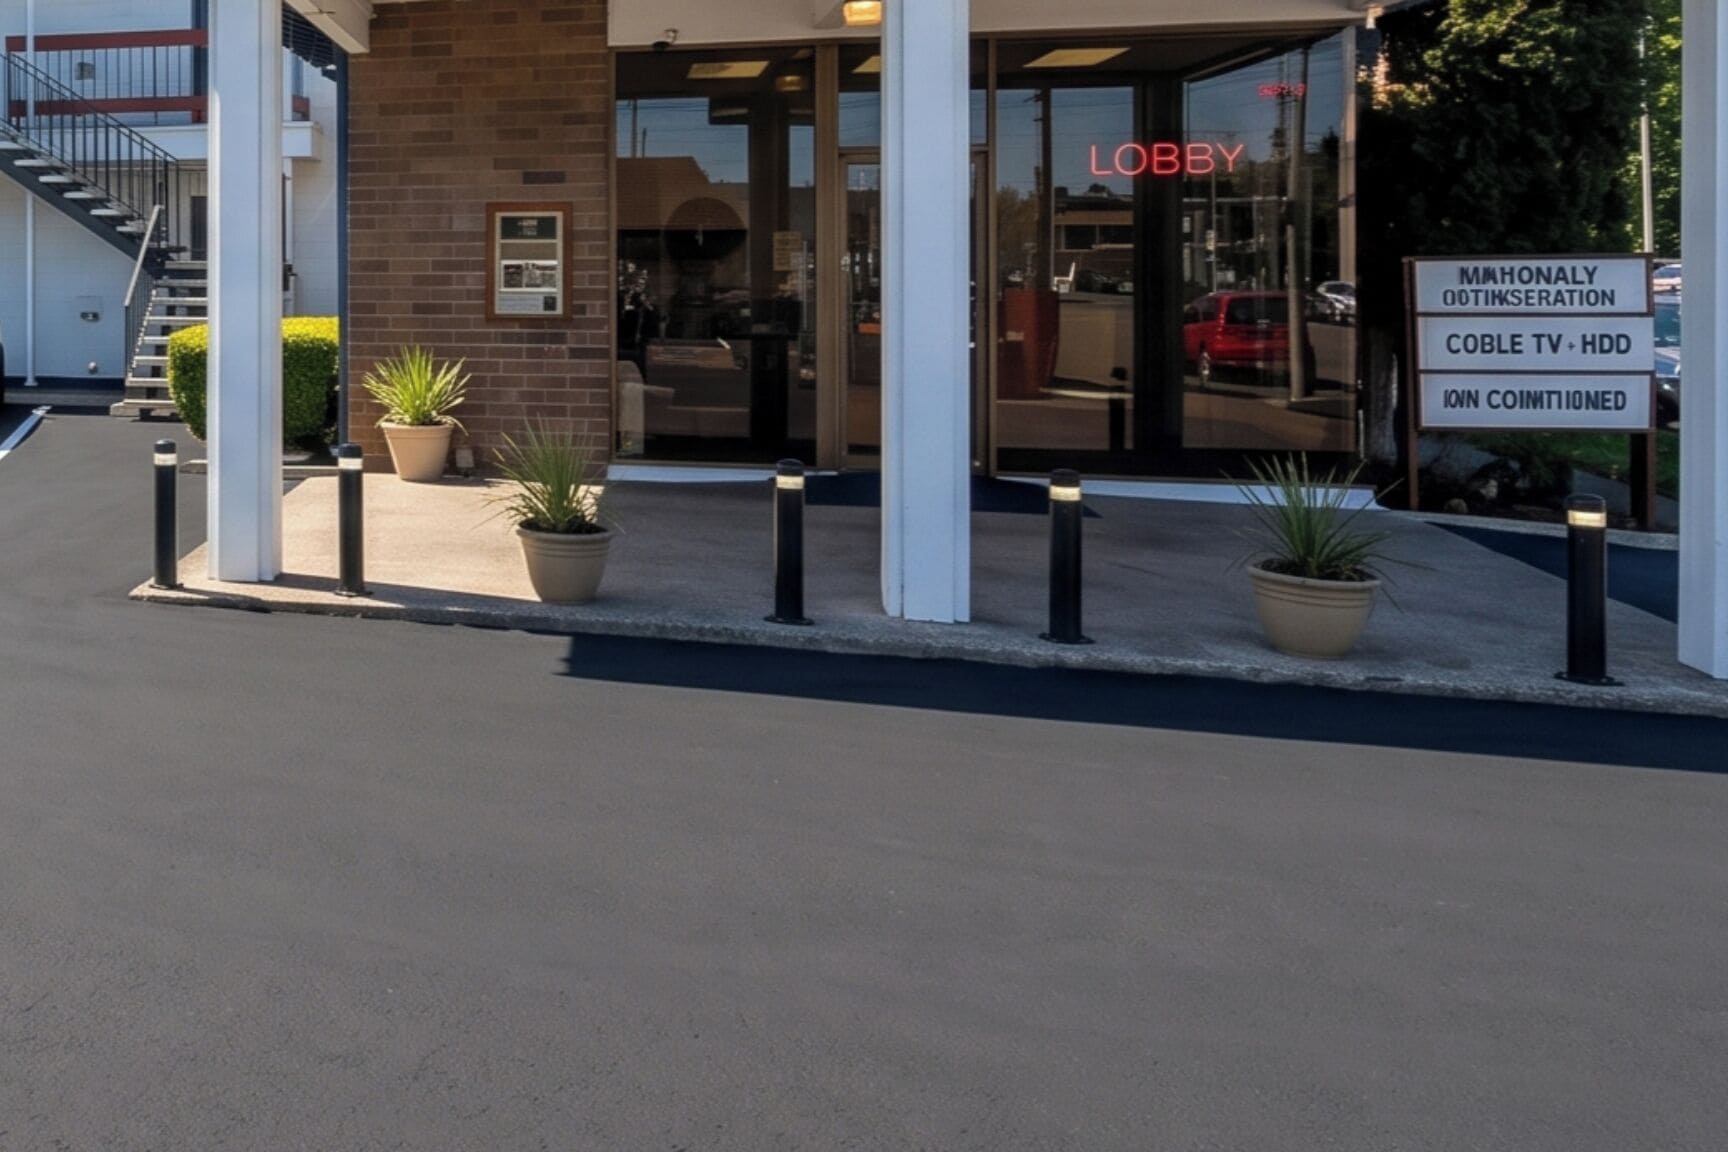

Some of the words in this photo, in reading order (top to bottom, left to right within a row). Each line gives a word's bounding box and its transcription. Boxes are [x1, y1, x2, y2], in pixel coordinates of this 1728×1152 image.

[1089, 142, 1245, 177] LOBBY
[1447, 334, 1523, 354] COBLE
[1532, 334, 1562, 354] TV
[1582, 334, 1631, 354] HDD
